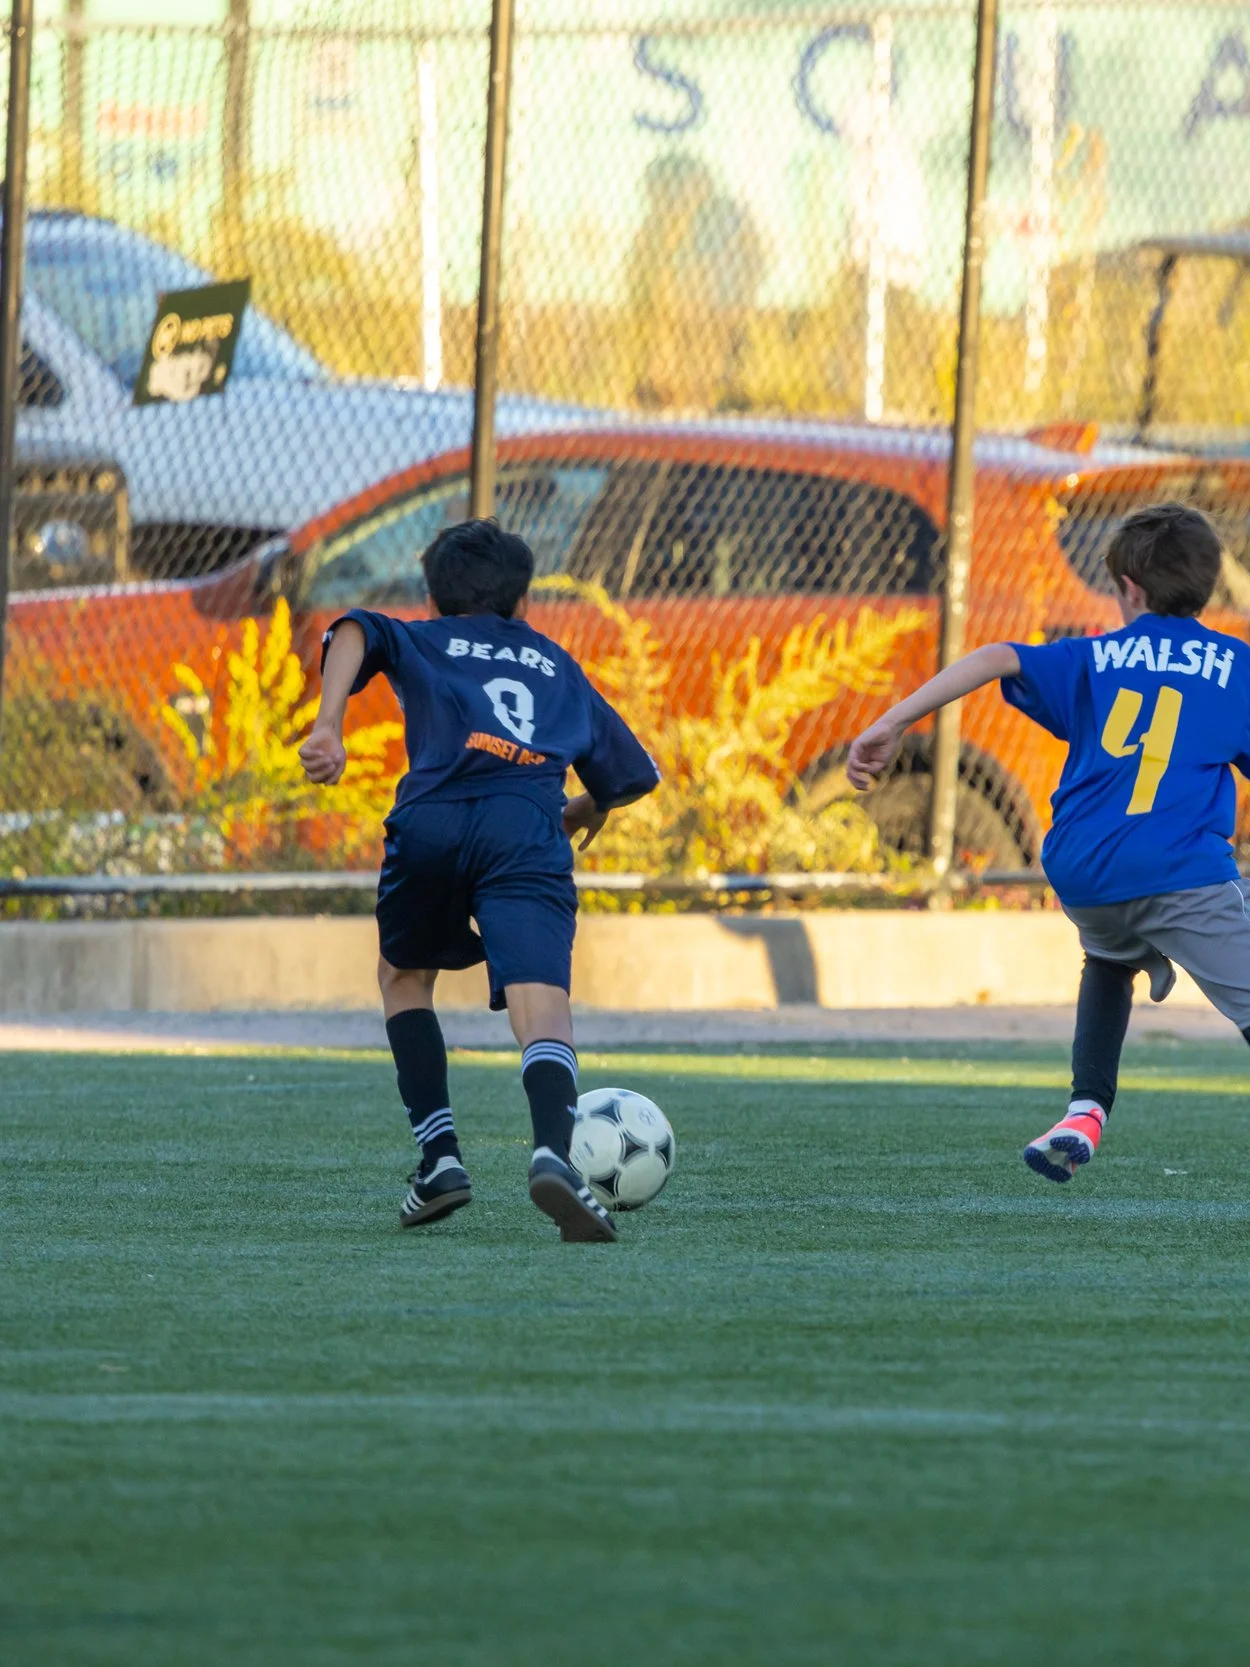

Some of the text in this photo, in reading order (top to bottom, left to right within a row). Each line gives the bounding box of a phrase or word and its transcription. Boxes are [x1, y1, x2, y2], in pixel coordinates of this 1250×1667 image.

[445, 637, 556, 677] BEARS
[1091, 635, 1235, 689] WALSH
[1101, 685, 1183, 815] 4
